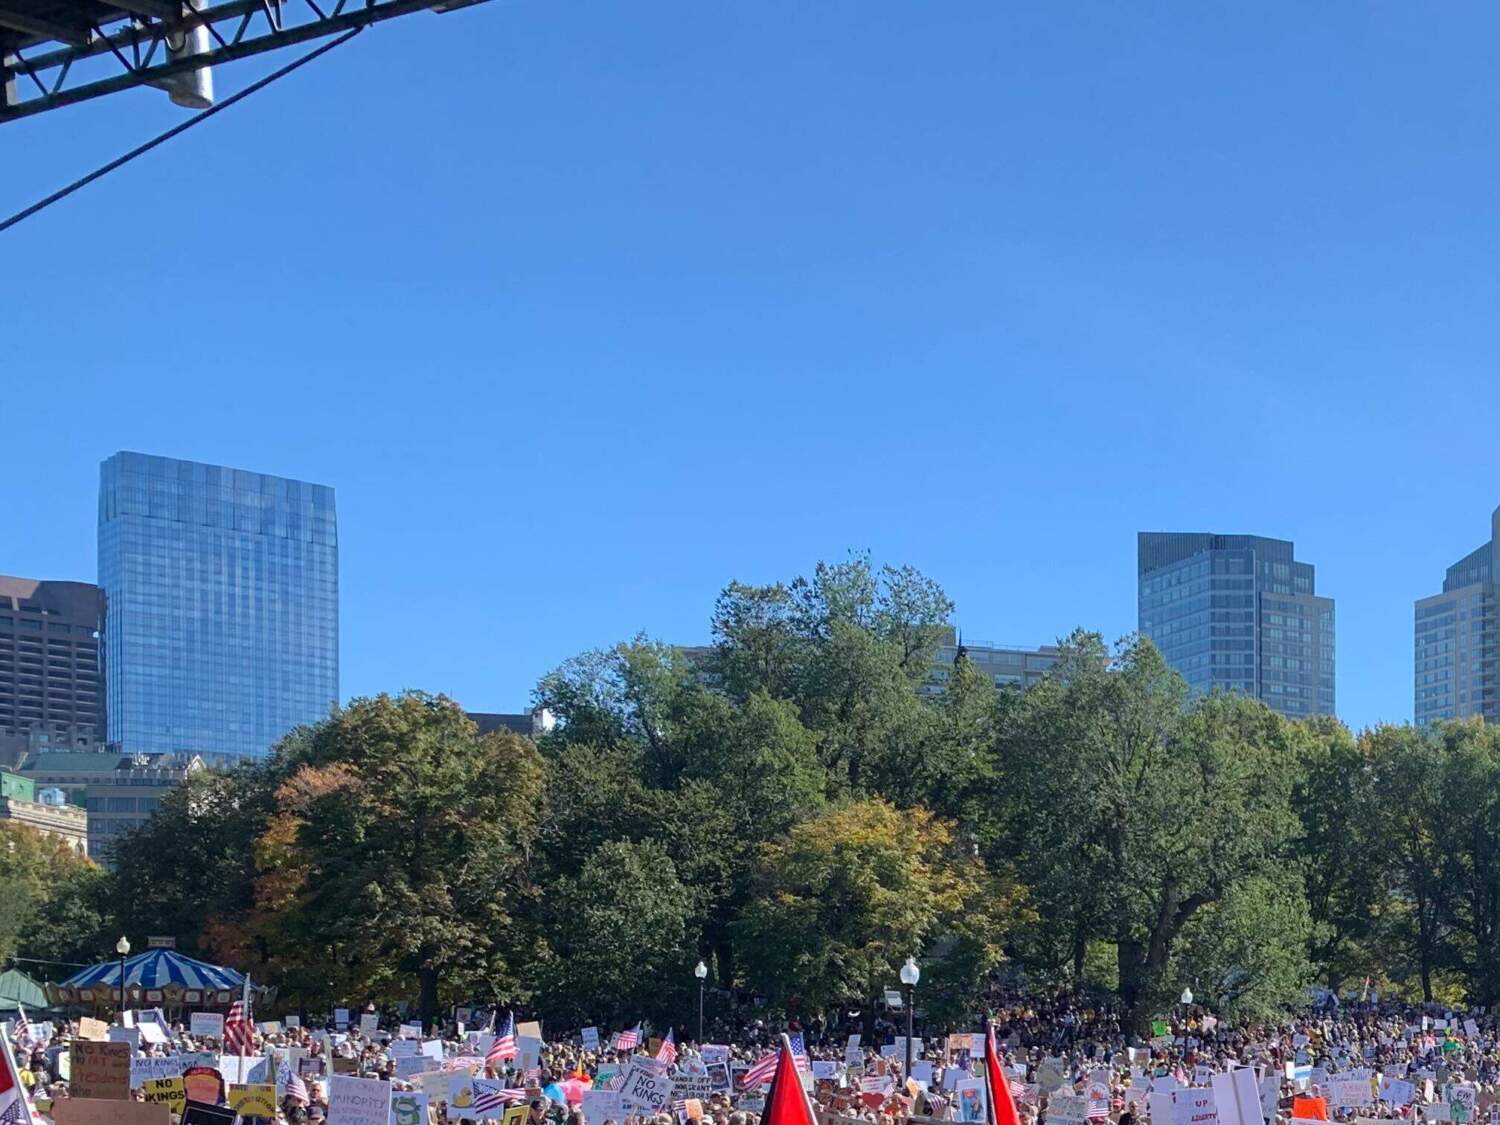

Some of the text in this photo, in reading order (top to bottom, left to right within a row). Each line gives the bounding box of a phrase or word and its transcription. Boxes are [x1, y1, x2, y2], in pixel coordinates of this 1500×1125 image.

[156, 1080, 172, 1088] NO
[637, 1076, 655, 1090] NO
[147, 1091, 184, 1102] KINGS
[632, 1086, 665, 1105] KINGS
